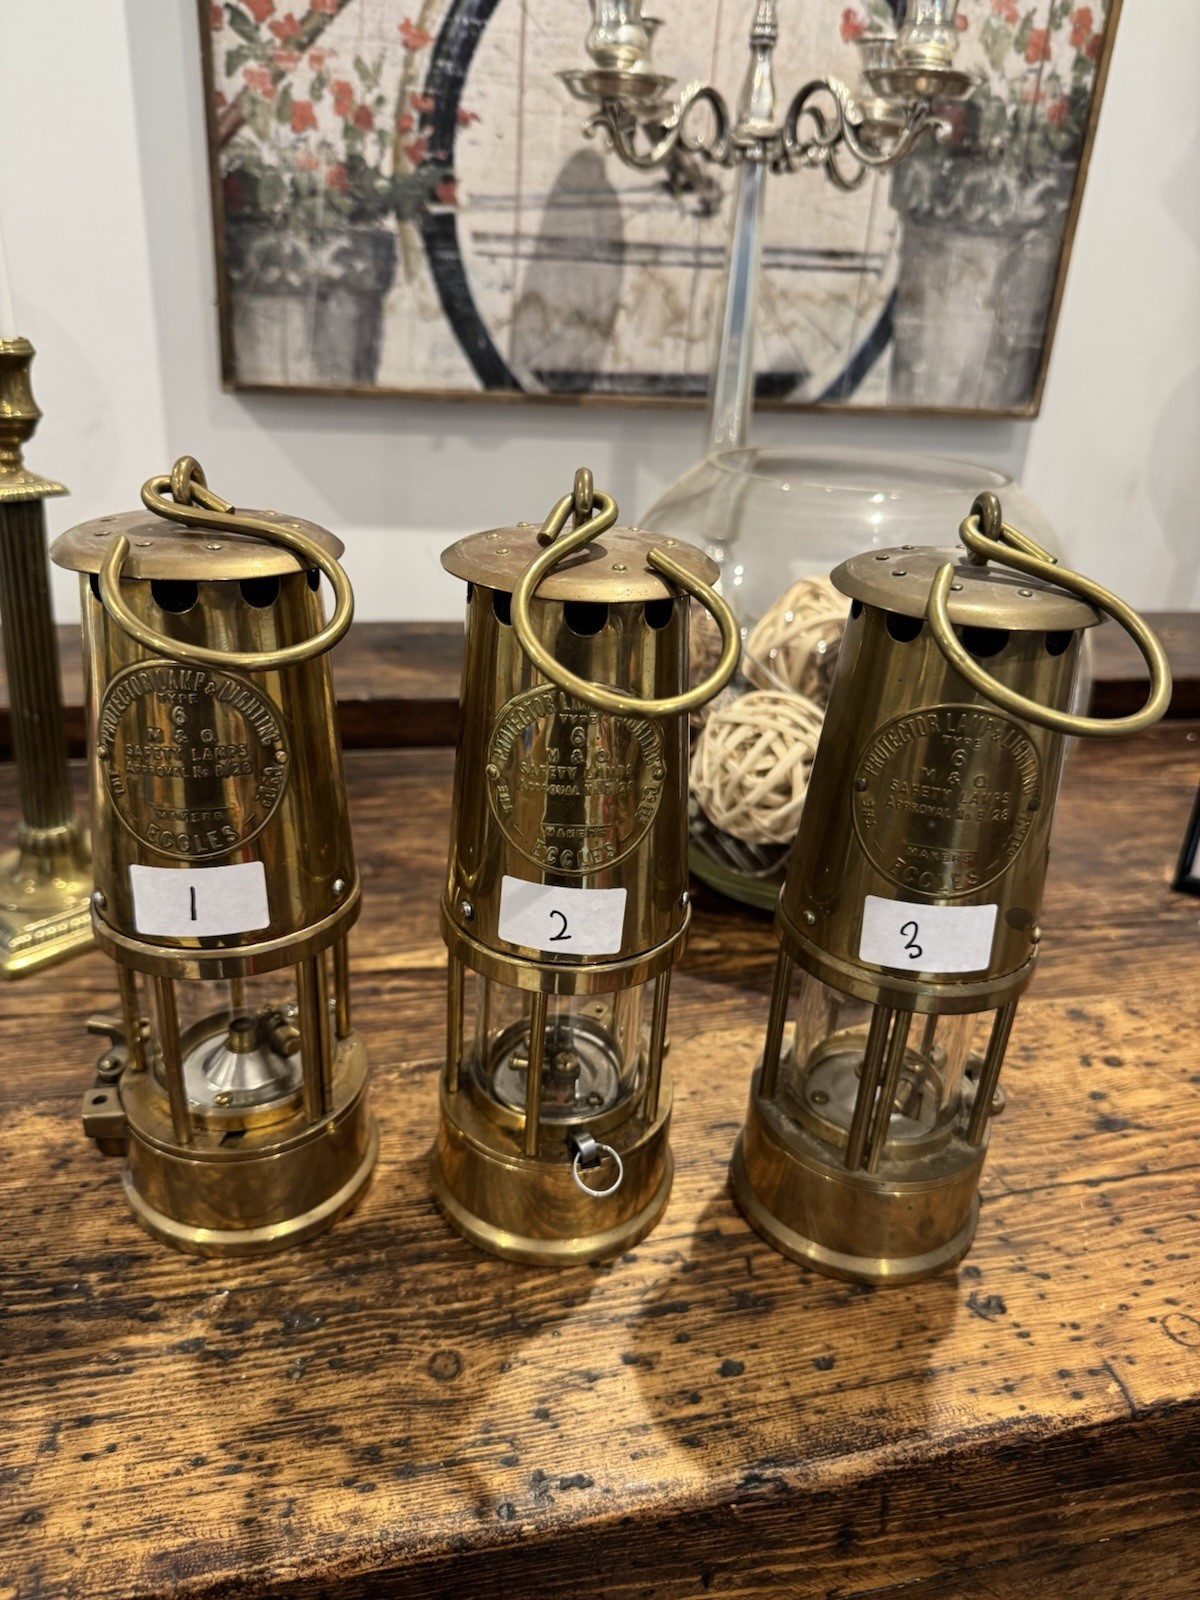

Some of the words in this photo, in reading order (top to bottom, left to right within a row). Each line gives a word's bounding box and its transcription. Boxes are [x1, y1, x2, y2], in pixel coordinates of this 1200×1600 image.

[102, 672, 152, 743] PROTECTOR
[154, 669, 205, 692] LAMP
[204, 681, 217, 695] &
[217, 680, 281, 746] LIGHTING
[157, 692, 199, 704] TYPE
[172, 706, 188, 724] 6
[559, 713, 597, 724] TYPE
[946, 711, 994, 736] LAMP
[175, 729, 189, 744] &
[494, 694, 556, 761] PROTECTOR
[570, 726, 585, 746] 6
[864, 713, 941, 776] PROTECTOR
[942, 734, 981, 748] TYPE
[125, 744, 183, 762] SAFETY
[192, 744, 248, 762] LAMPS
[546, 747, 559, 763] M
[571, 749, 586, 764] &
[951, 749, 967, 767] 6
[520, 761, 578, 780] SAFETY
[922, 767, 936, 782] M
[948, 771, 961, 785] &
[973, 774, 988, 789] Q
[890, 778, 952, 801] SAFETY
[959, 790, 1010, 806] LAMPS
[156, 811, 224, 823] MAKERS
[862, 800, 877, 830] THE
[147, 823, 238, 853] ECCLES
[533, 839, 615, 868] ECCLES
[907, 846, 972, 864] MAKERS
[890, 857, 978, 892] ECCLES
[190, 886, 197, 922] 1
[549, 910, 572, 941] 2
[899, 920, 924, 959] 3
